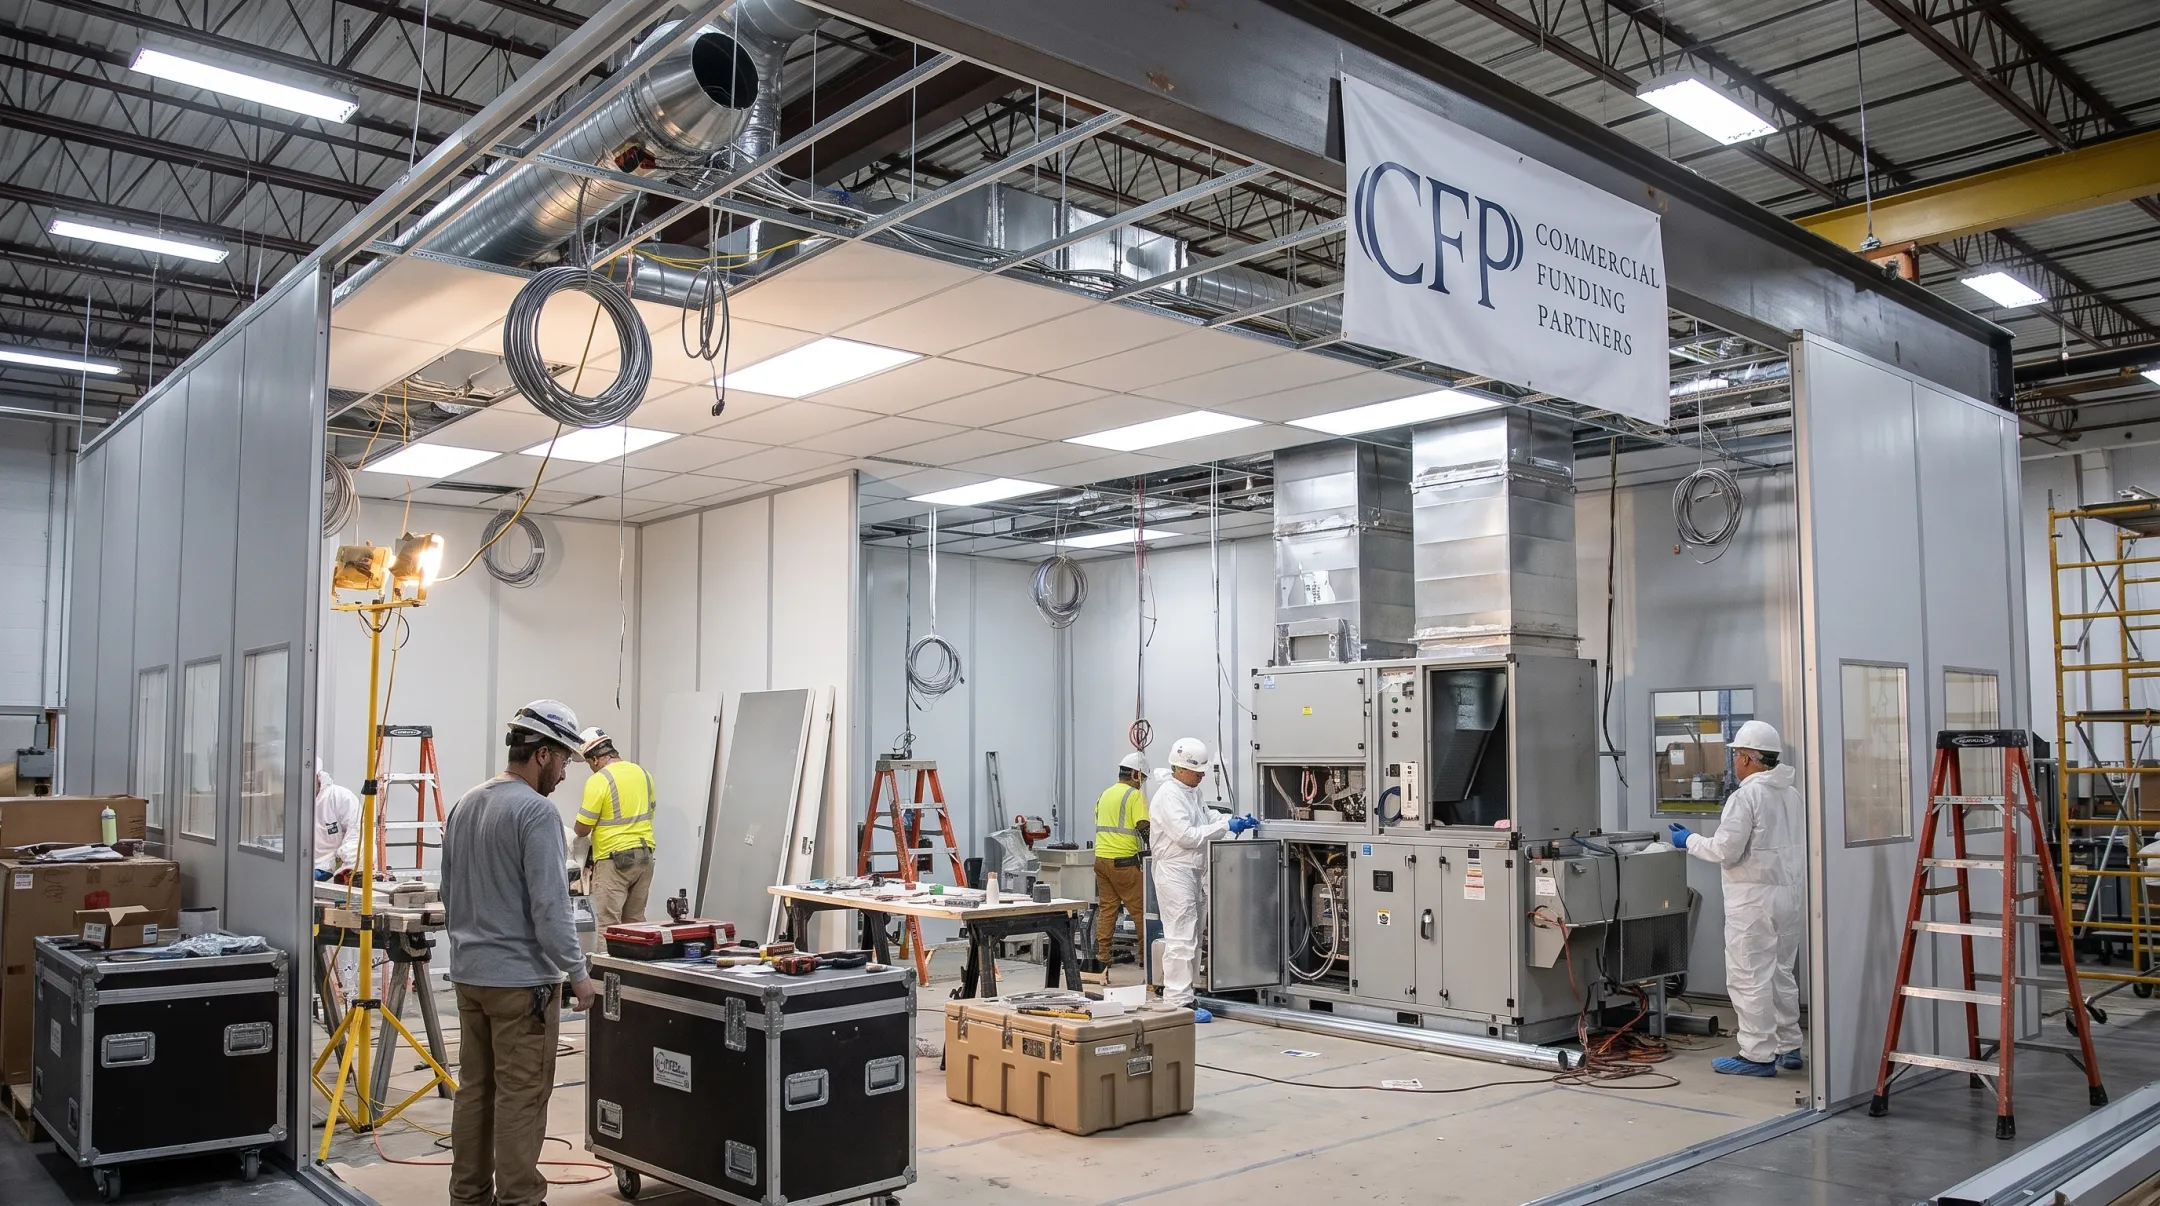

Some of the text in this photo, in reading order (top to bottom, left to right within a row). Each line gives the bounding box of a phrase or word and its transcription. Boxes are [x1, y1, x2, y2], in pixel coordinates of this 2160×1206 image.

[1362, 162, 1517, 311] CFP
[1536, 223, 1660, 289] COMMERCIAL
[1537, 263, 1625, 314] FUNDING
[1538, 304, 1632, 356] PARTNERS
